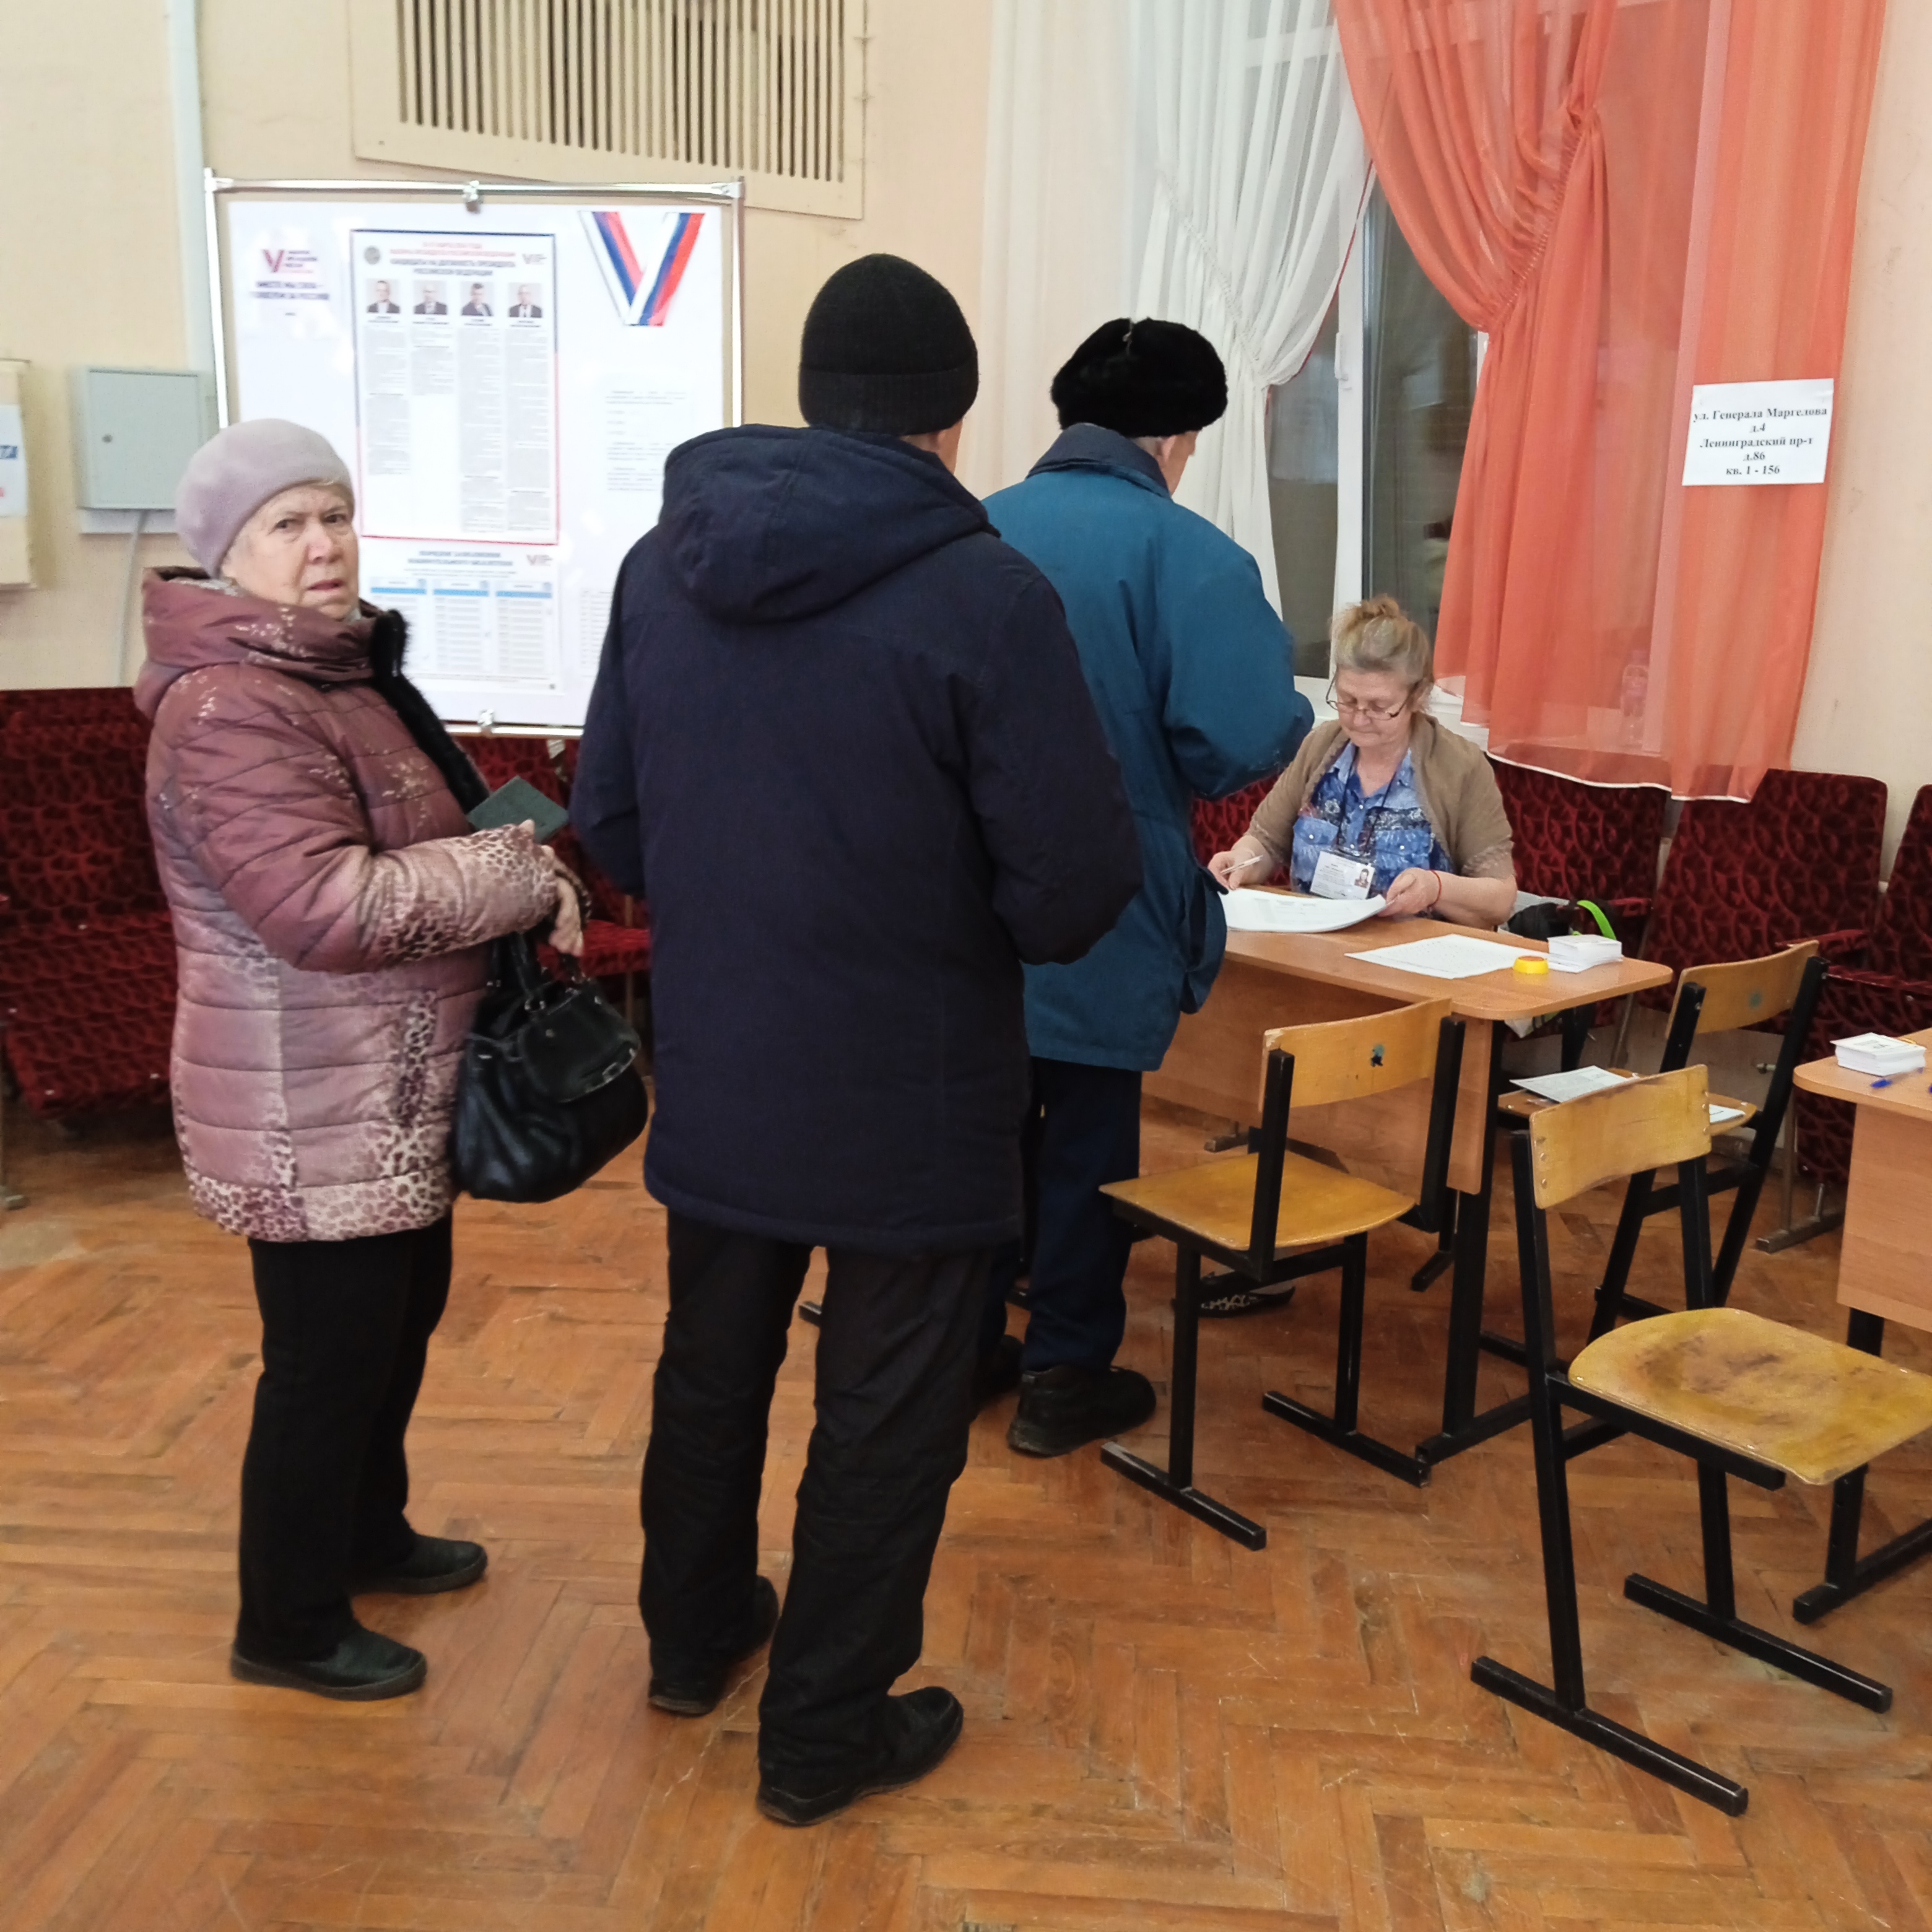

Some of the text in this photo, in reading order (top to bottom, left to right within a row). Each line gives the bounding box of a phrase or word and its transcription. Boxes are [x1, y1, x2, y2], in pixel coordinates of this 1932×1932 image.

[1693, 407, 1827, 423] ул. Генерала Маргелова
[1749, 422, 1766, 433] д.4
[1700, 437, 1813, 448] Ленинградский пр-т
[1743, 451, 1765, 461] д.86
[1725, 467, 1742, 475] кв.
[1746, 466, 1751, 474] 1
[1762, 465, 1780, 474] 156
